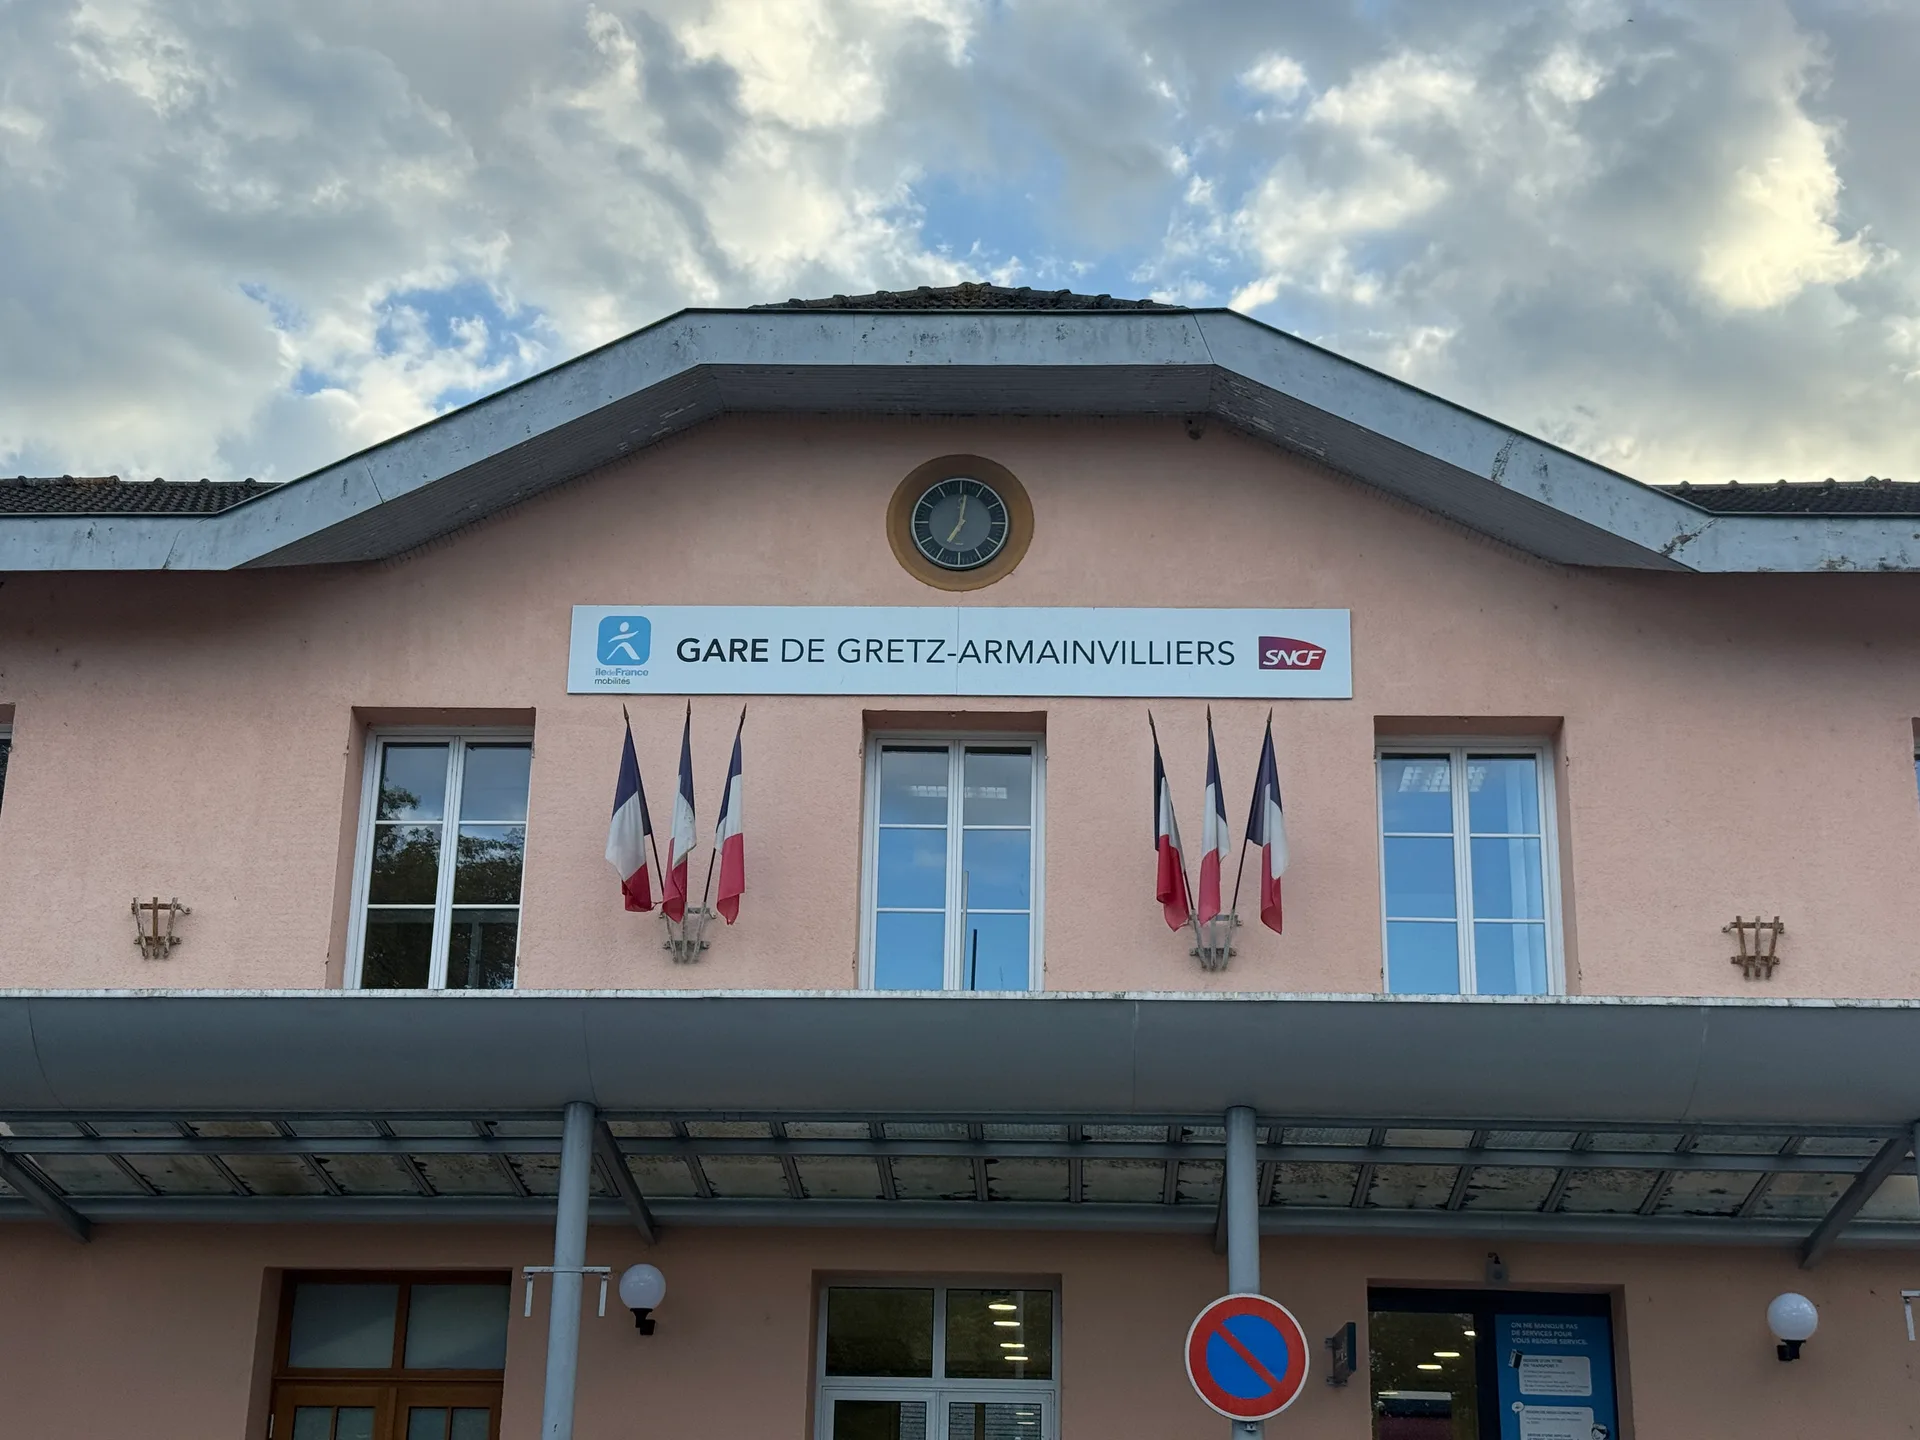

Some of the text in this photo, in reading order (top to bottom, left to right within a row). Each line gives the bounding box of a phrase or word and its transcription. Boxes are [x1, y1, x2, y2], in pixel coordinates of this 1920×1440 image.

[676, 637, 1235, 666] GARE DE GRETZ-ARMAINVILLIERS
[1262, 648, 1324, 667] SNCF
